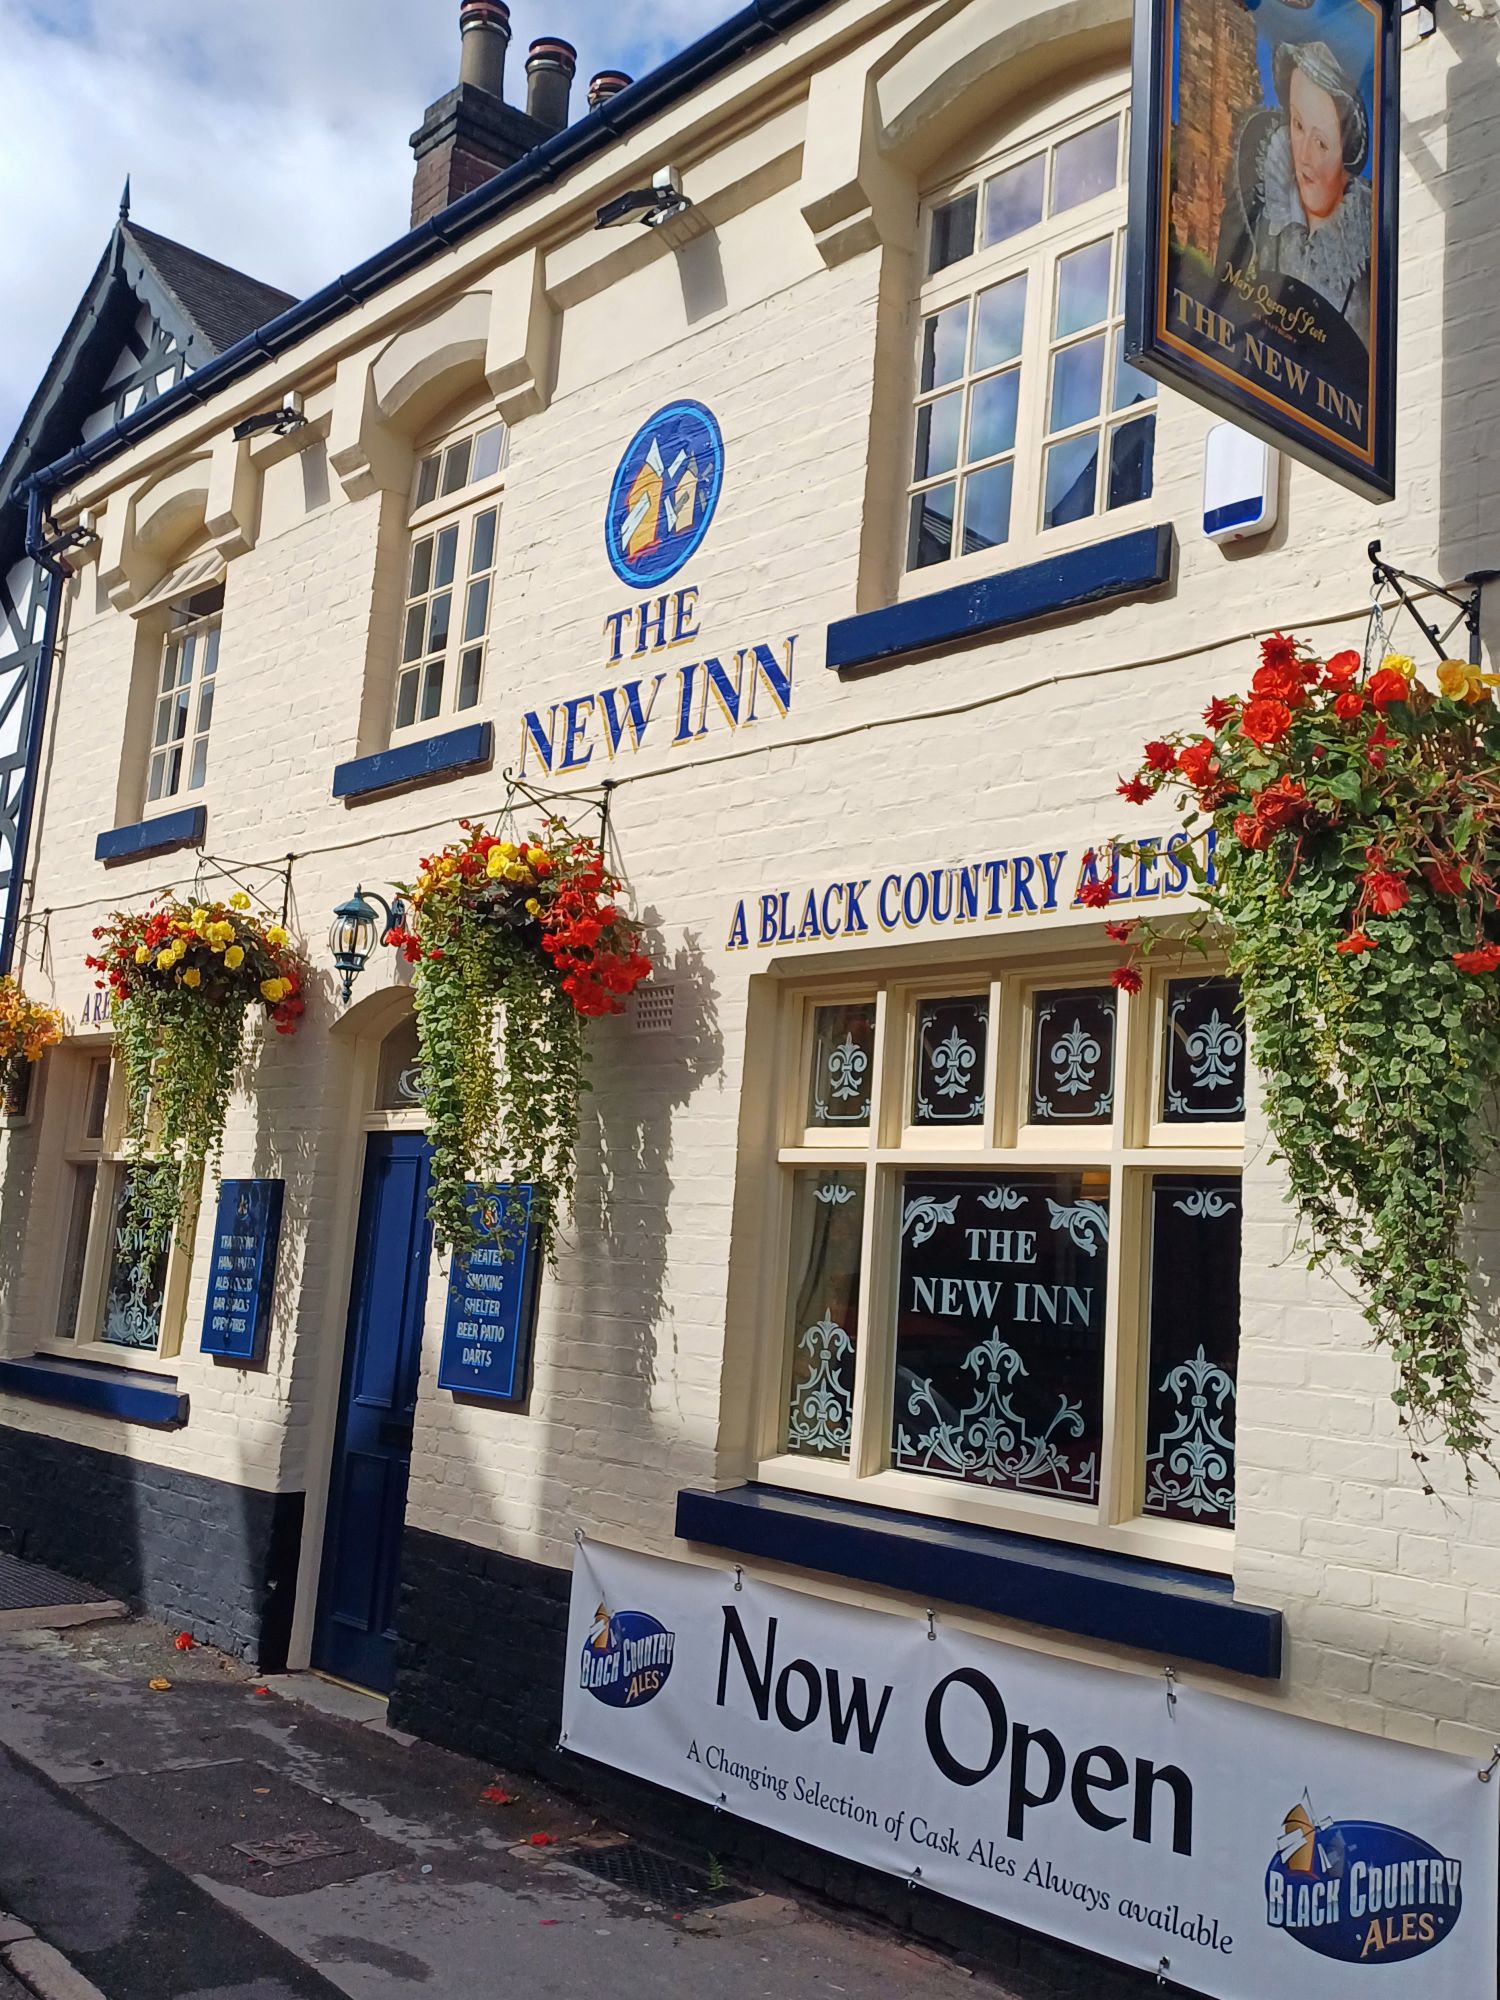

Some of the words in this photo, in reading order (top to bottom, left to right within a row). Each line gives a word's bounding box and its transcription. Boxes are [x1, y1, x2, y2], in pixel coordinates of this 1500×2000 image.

[1221, 261, 1254, 300] Mary
[1281, 306, 1304, 331] of
[1174, 288, 1236, 353] THE
[1244, 332, 1311, 395] NEW
[1316, 377, 1363, 432] INN
[603, 585, 700, 668] THE
[519, 673, 666, 778] NEW
[672, 635, 799, 747] INN
[725, 898, 748, 951] A
[757, 879, 871, 948] BLACK
[877, 850, 1068, 930] COUNTRY
[1070, 832, 1189, 910] ALES
[965, 1228, 1037, 1264] THE
[463, 1297, 501, 1318] SHELTER
[465, 1272, 504, 1292] SMOKING
[910, 1275, 1003, 1319] NEW
[1013, 1282, 1094, 1328] INN
[456, 1321, 479, 1340] BEER
[480, 1324, 505, 1342] PATIO
[462, 1347, 492, 1367] DARTS
[580, 1649, 621, 1688] BLACK
[622, 1632, 675, 1677] COUNTRY
[625, 1669, 660, 1704] ALES
[925, 1667, 1193, 1856] Open
[686, 1739, 701, 1763] A
[705, 1745, 789, 1801] Changing
[793, 1776, 878, 1828] Selection
[884, 1811, 905, 1841] of
[909, 1817, 960, 1857] Cask
[966, 1838, 1016, 1876] Ales
[1023, 1857, 1111, 1912] Always
[1118, 1898, 1233, 1954] available
[1268, 1870, 1341, 1927] BLACK
[1350, 1859, 1461, 1918] COUNTRY
[1360, 1912, 1435, 1958] ALES
